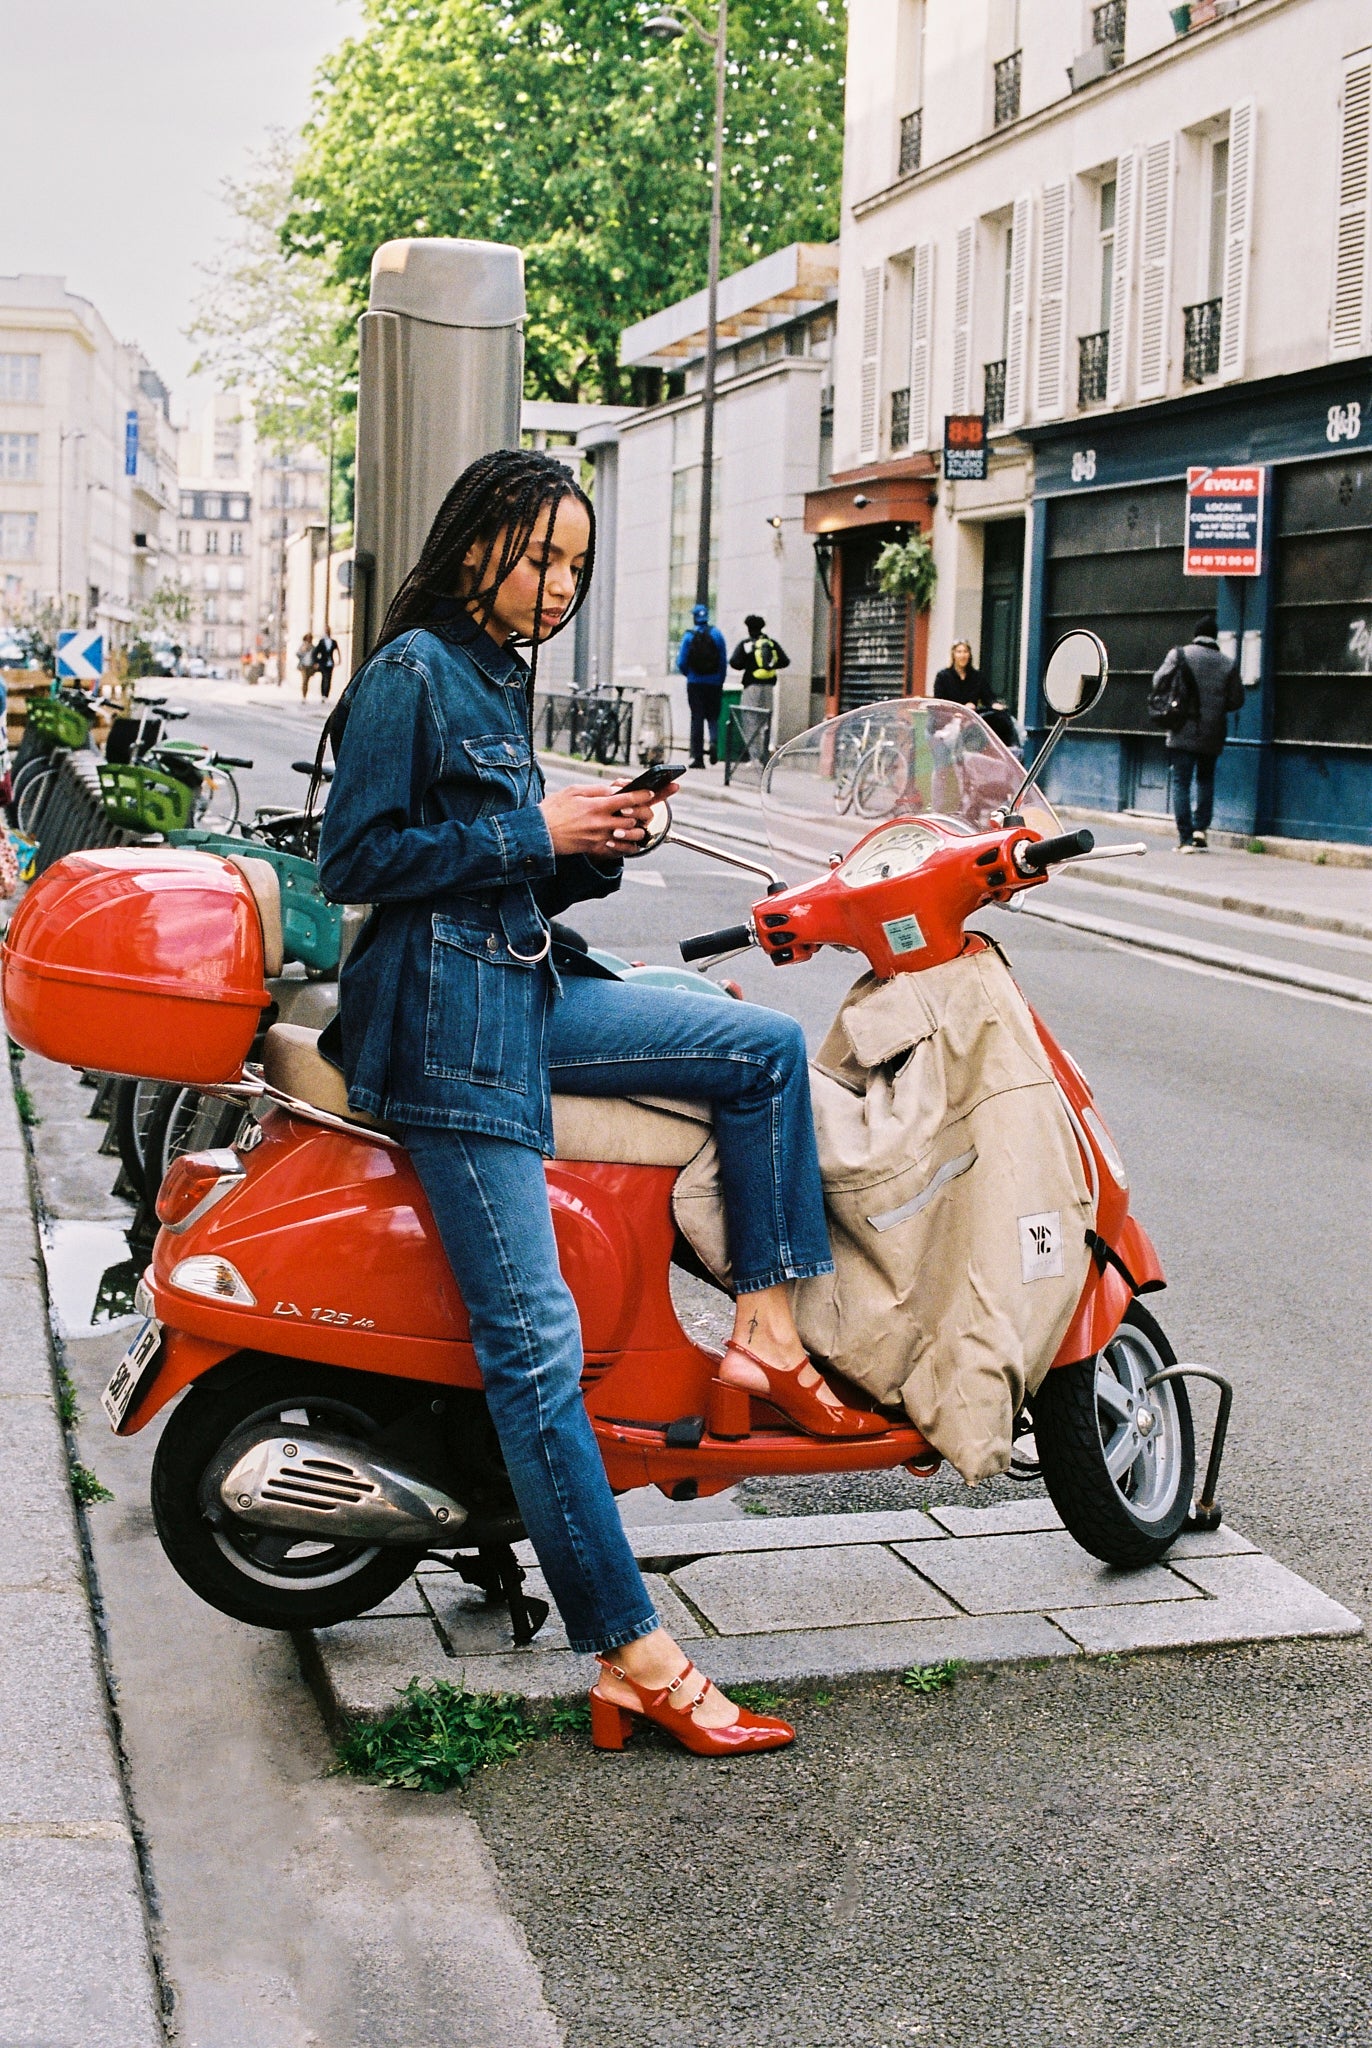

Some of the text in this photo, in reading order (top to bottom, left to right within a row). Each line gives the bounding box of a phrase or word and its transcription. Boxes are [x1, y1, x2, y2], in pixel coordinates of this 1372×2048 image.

[947, 449, 984, 459] GALERIE
[947, 460, 984, 468] STUDIO
[947, 469, 984, 478] PHOTO
[1205, 502, 1242, 512] LOCAUX
[1190, 513, 1257, 523] COMMERCIAUX
[1214, 555, 1227, 566] 72
[273, 1301, 303, 1317] LX
[311, 1307, 353, 1325] 125
